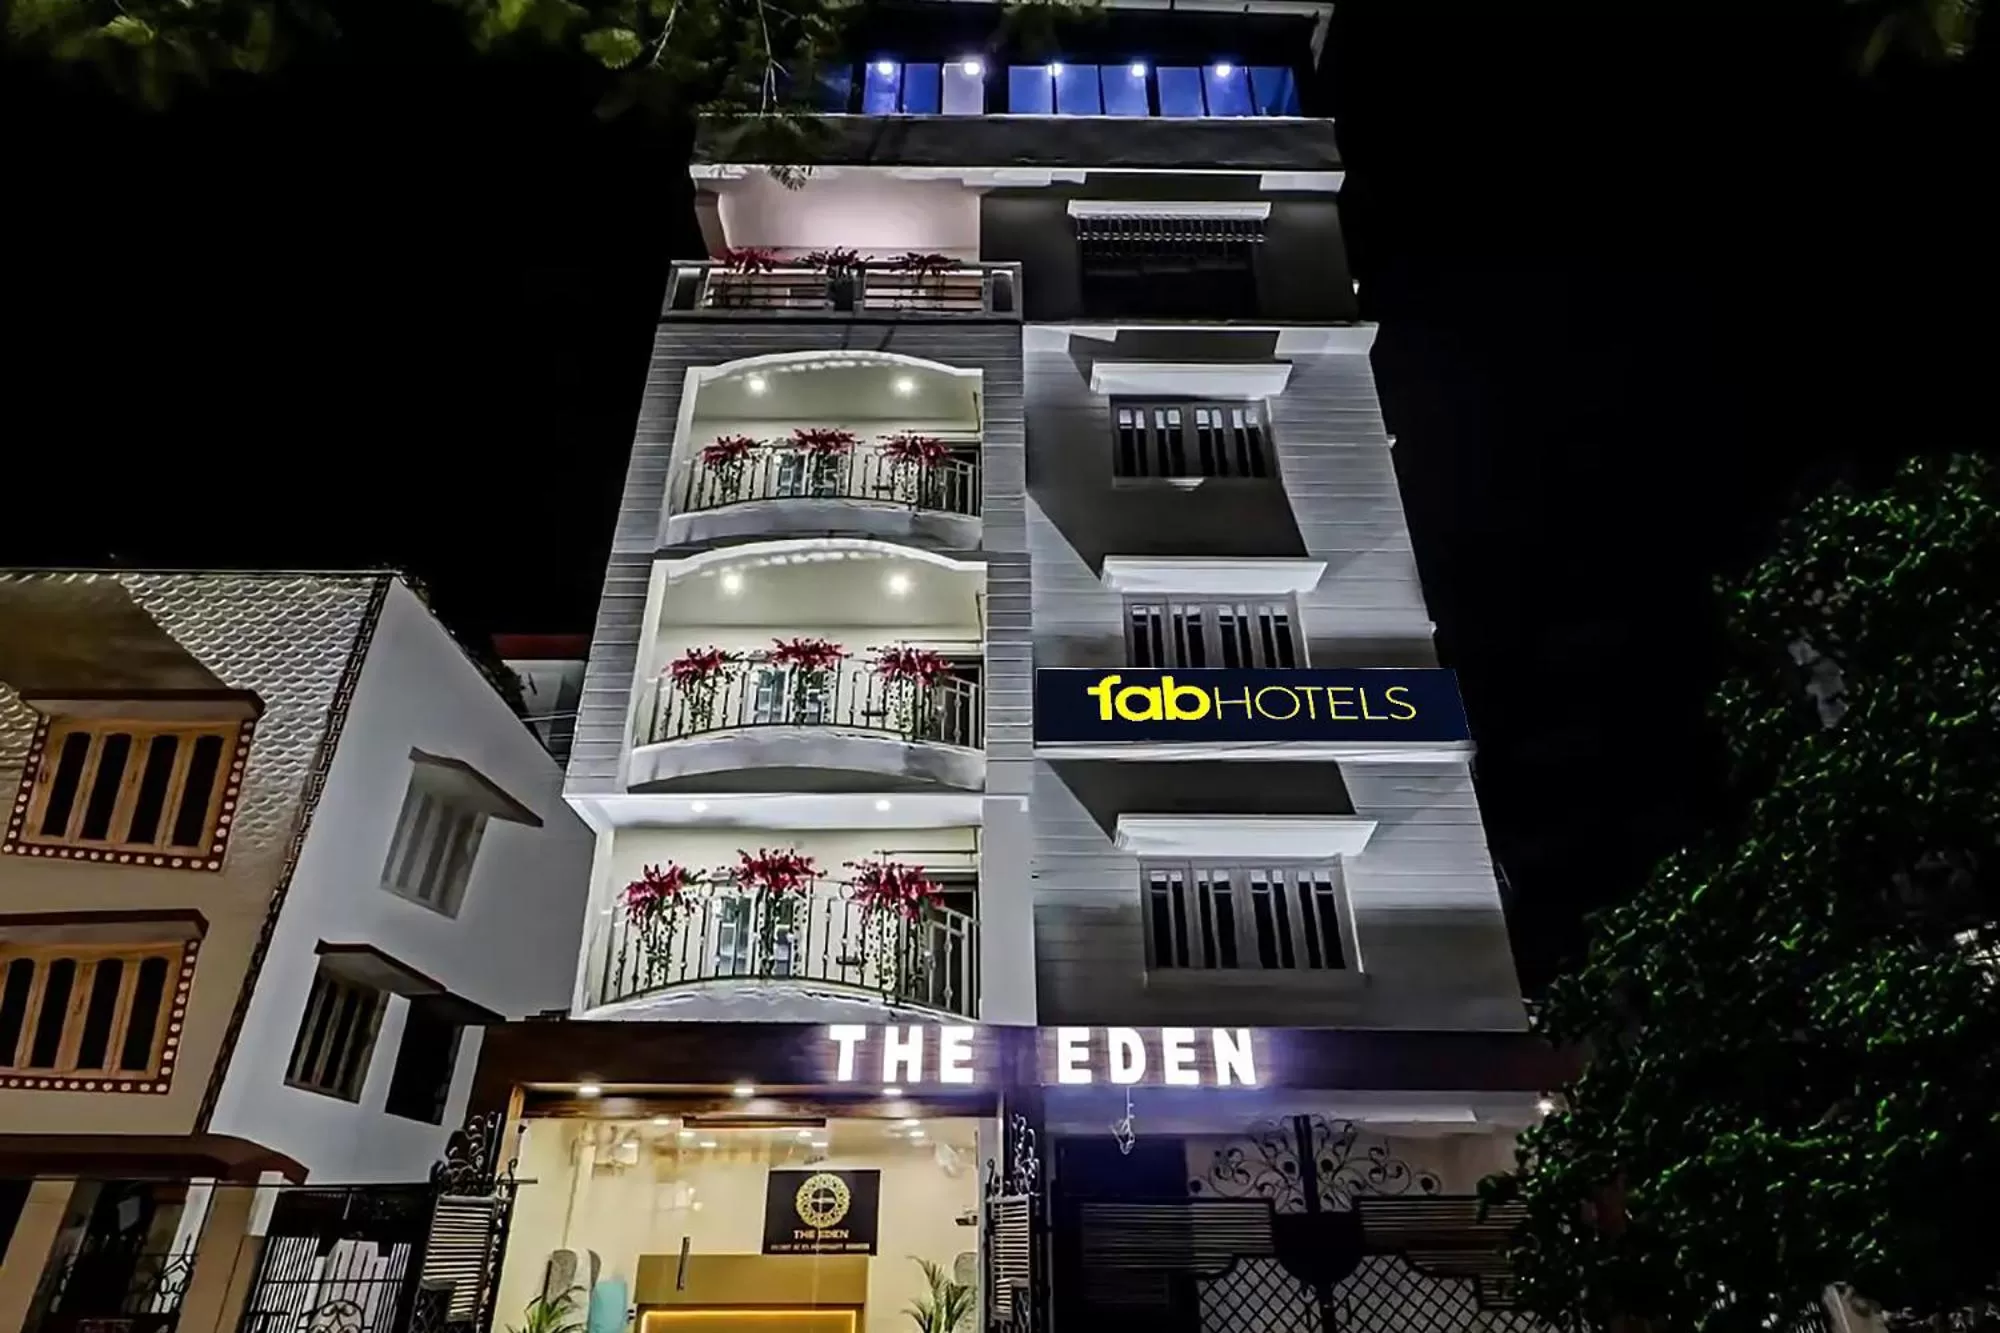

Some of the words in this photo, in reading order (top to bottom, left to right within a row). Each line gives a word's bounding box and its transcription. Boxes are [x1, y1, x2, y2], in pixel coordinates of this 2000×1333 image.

[829, 1025, 975, 1083] THE
[1057, 1027, 1257, 1086] EDEN
[793, 1229, 816, 1239] THE
